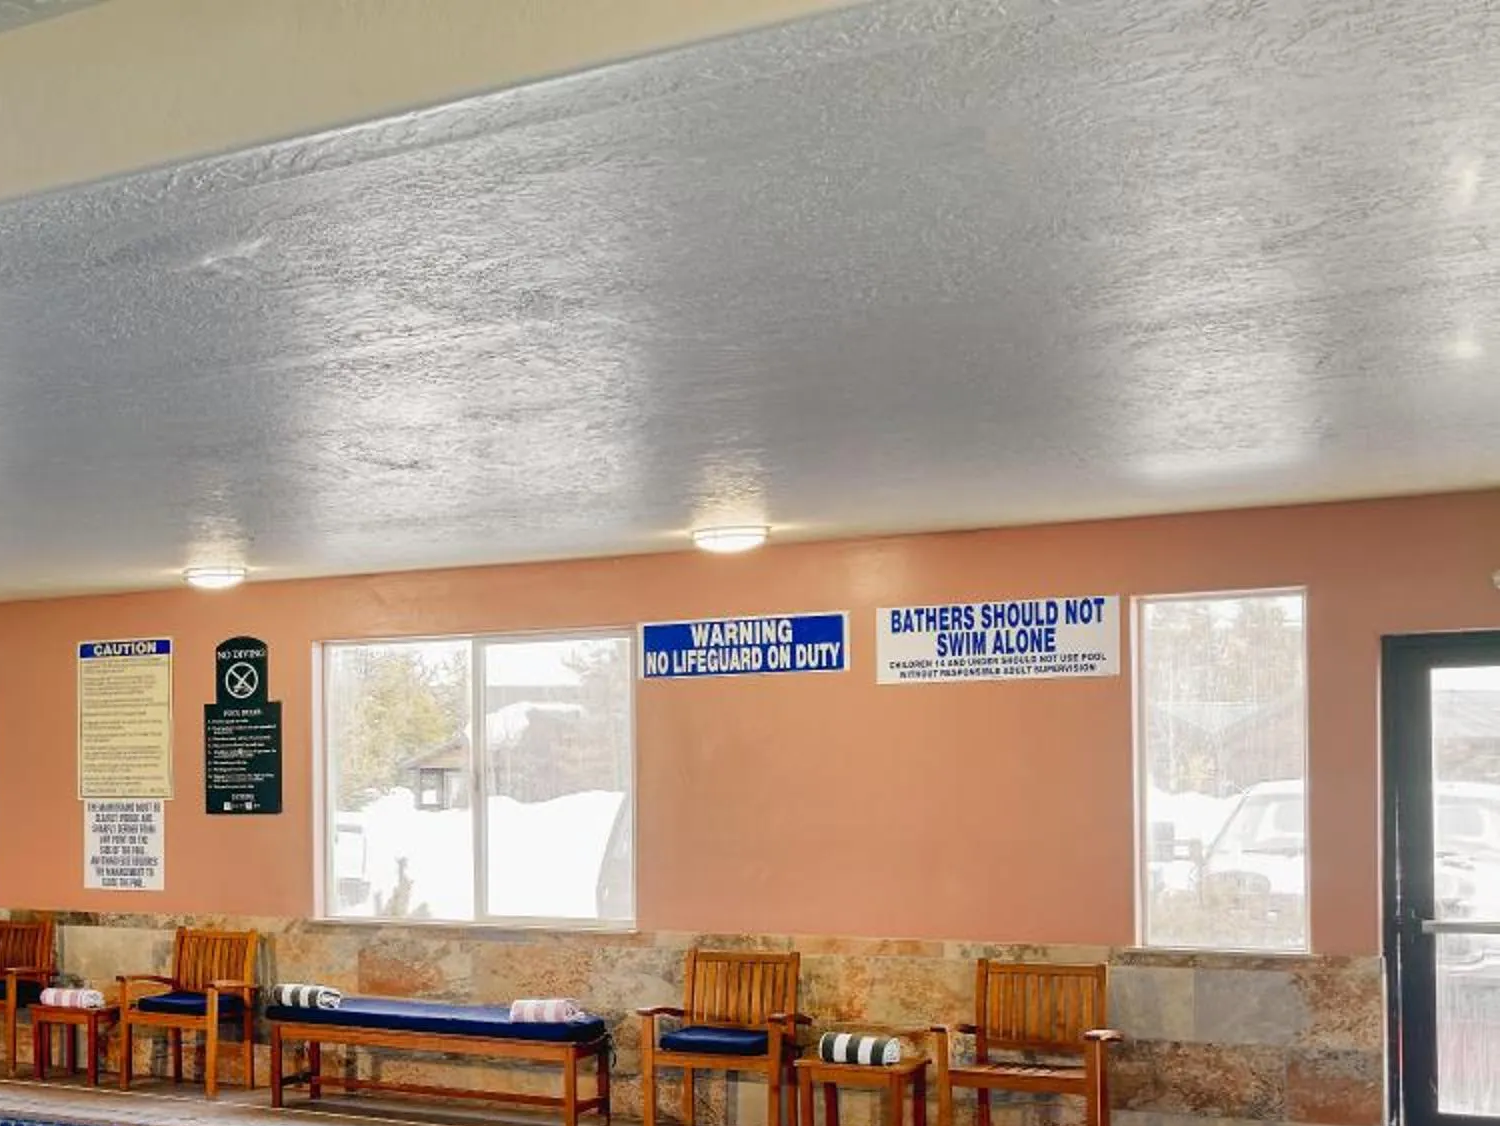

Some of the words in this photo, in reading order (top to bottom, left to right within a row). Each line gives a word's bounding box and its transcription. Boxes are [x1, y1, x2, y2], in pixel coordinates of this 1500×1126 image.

[891, 605, 975, 633] BATHERS
[981, 600, 1058, 629] SHOULD
[1065, 598, 1105, 625] NOT
[93, 641, 157, 656] CAUTION
[691, 620, 793, 647] WARNING
[937, 631, 987, 657] SWIM
[993, 627, 1056, 654] ALONE
[646, 651, 669, 674] NO
[673, 646, 763, 673] LIFEGUARD
[767, 645, 791, 669] ON
[795, 642, 841, 668] DUTY
